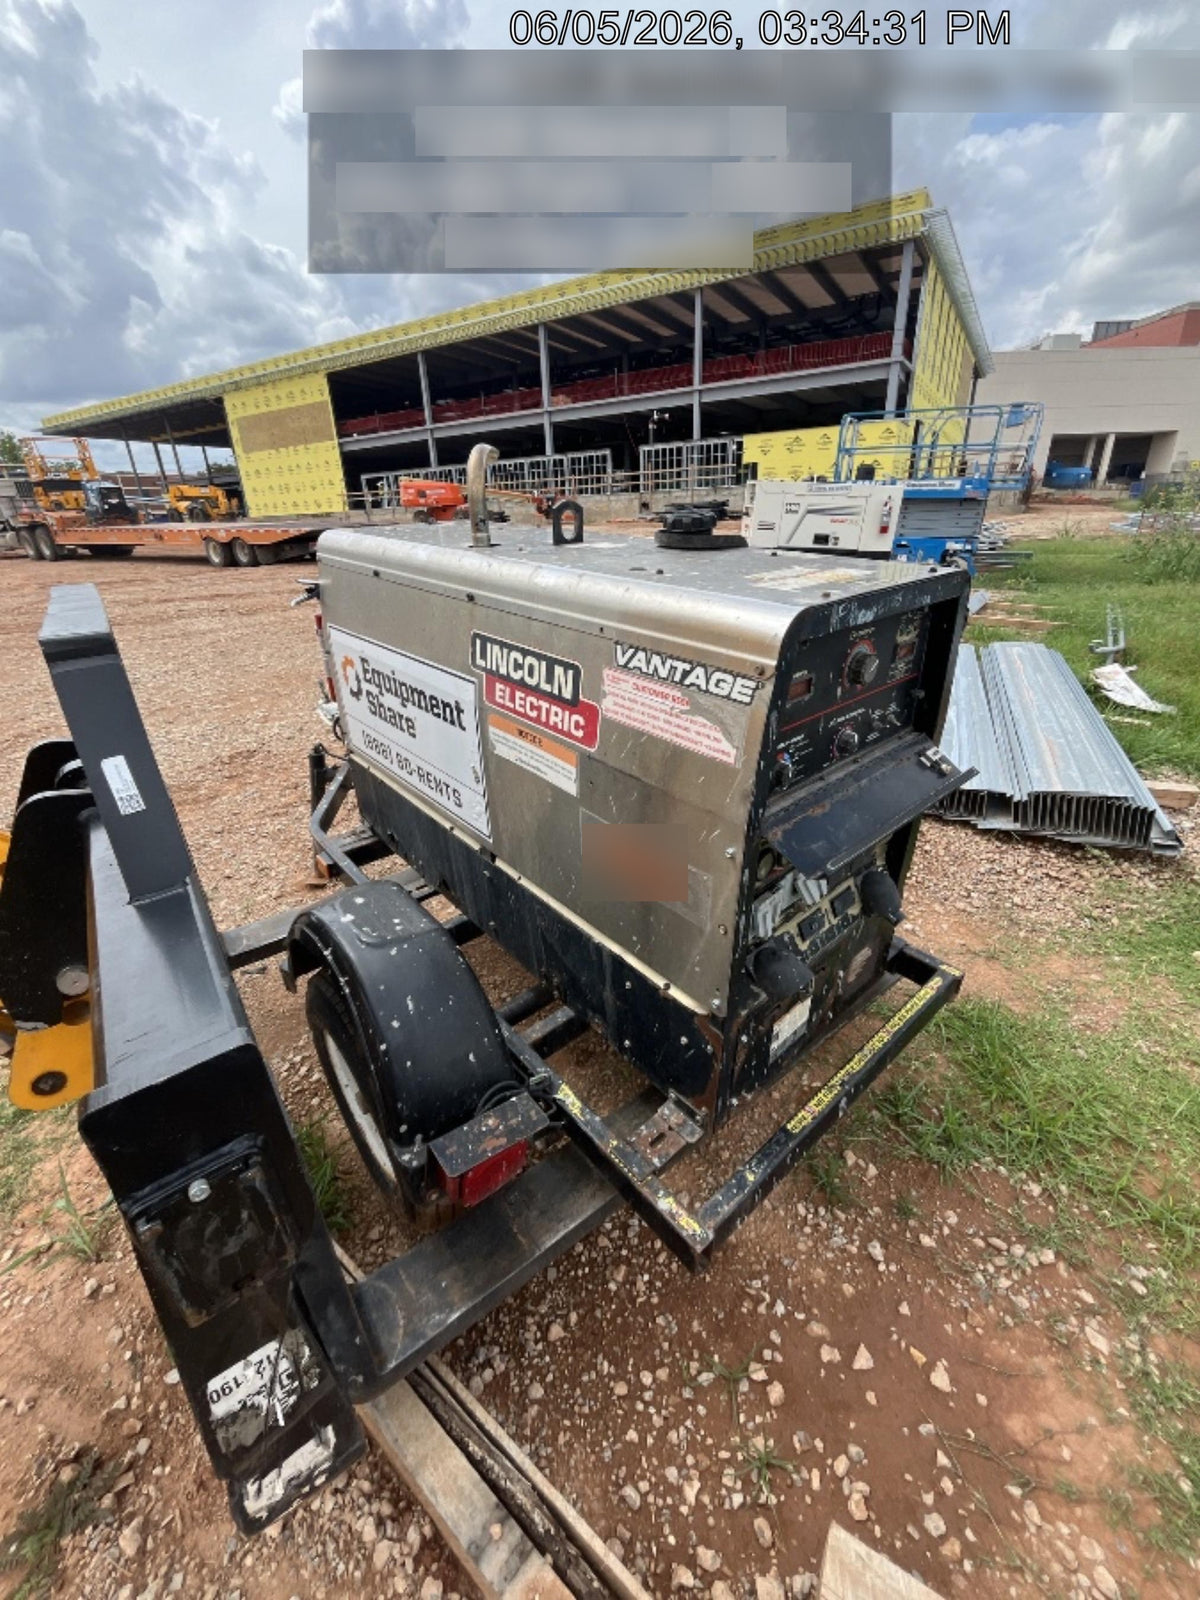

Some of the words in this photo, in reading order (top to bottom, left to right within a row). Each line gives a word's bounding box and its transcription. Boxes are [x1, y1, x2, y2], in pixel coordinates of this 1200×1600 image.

[358, 655, 467, 731] Equipment
[475, 638, 574, 700] LINCOLN
[615, 643, 758, 704] VANTAGE
[365, 688, 417, 739] Share
[494, 682, 585, 738] ELECTRIC
